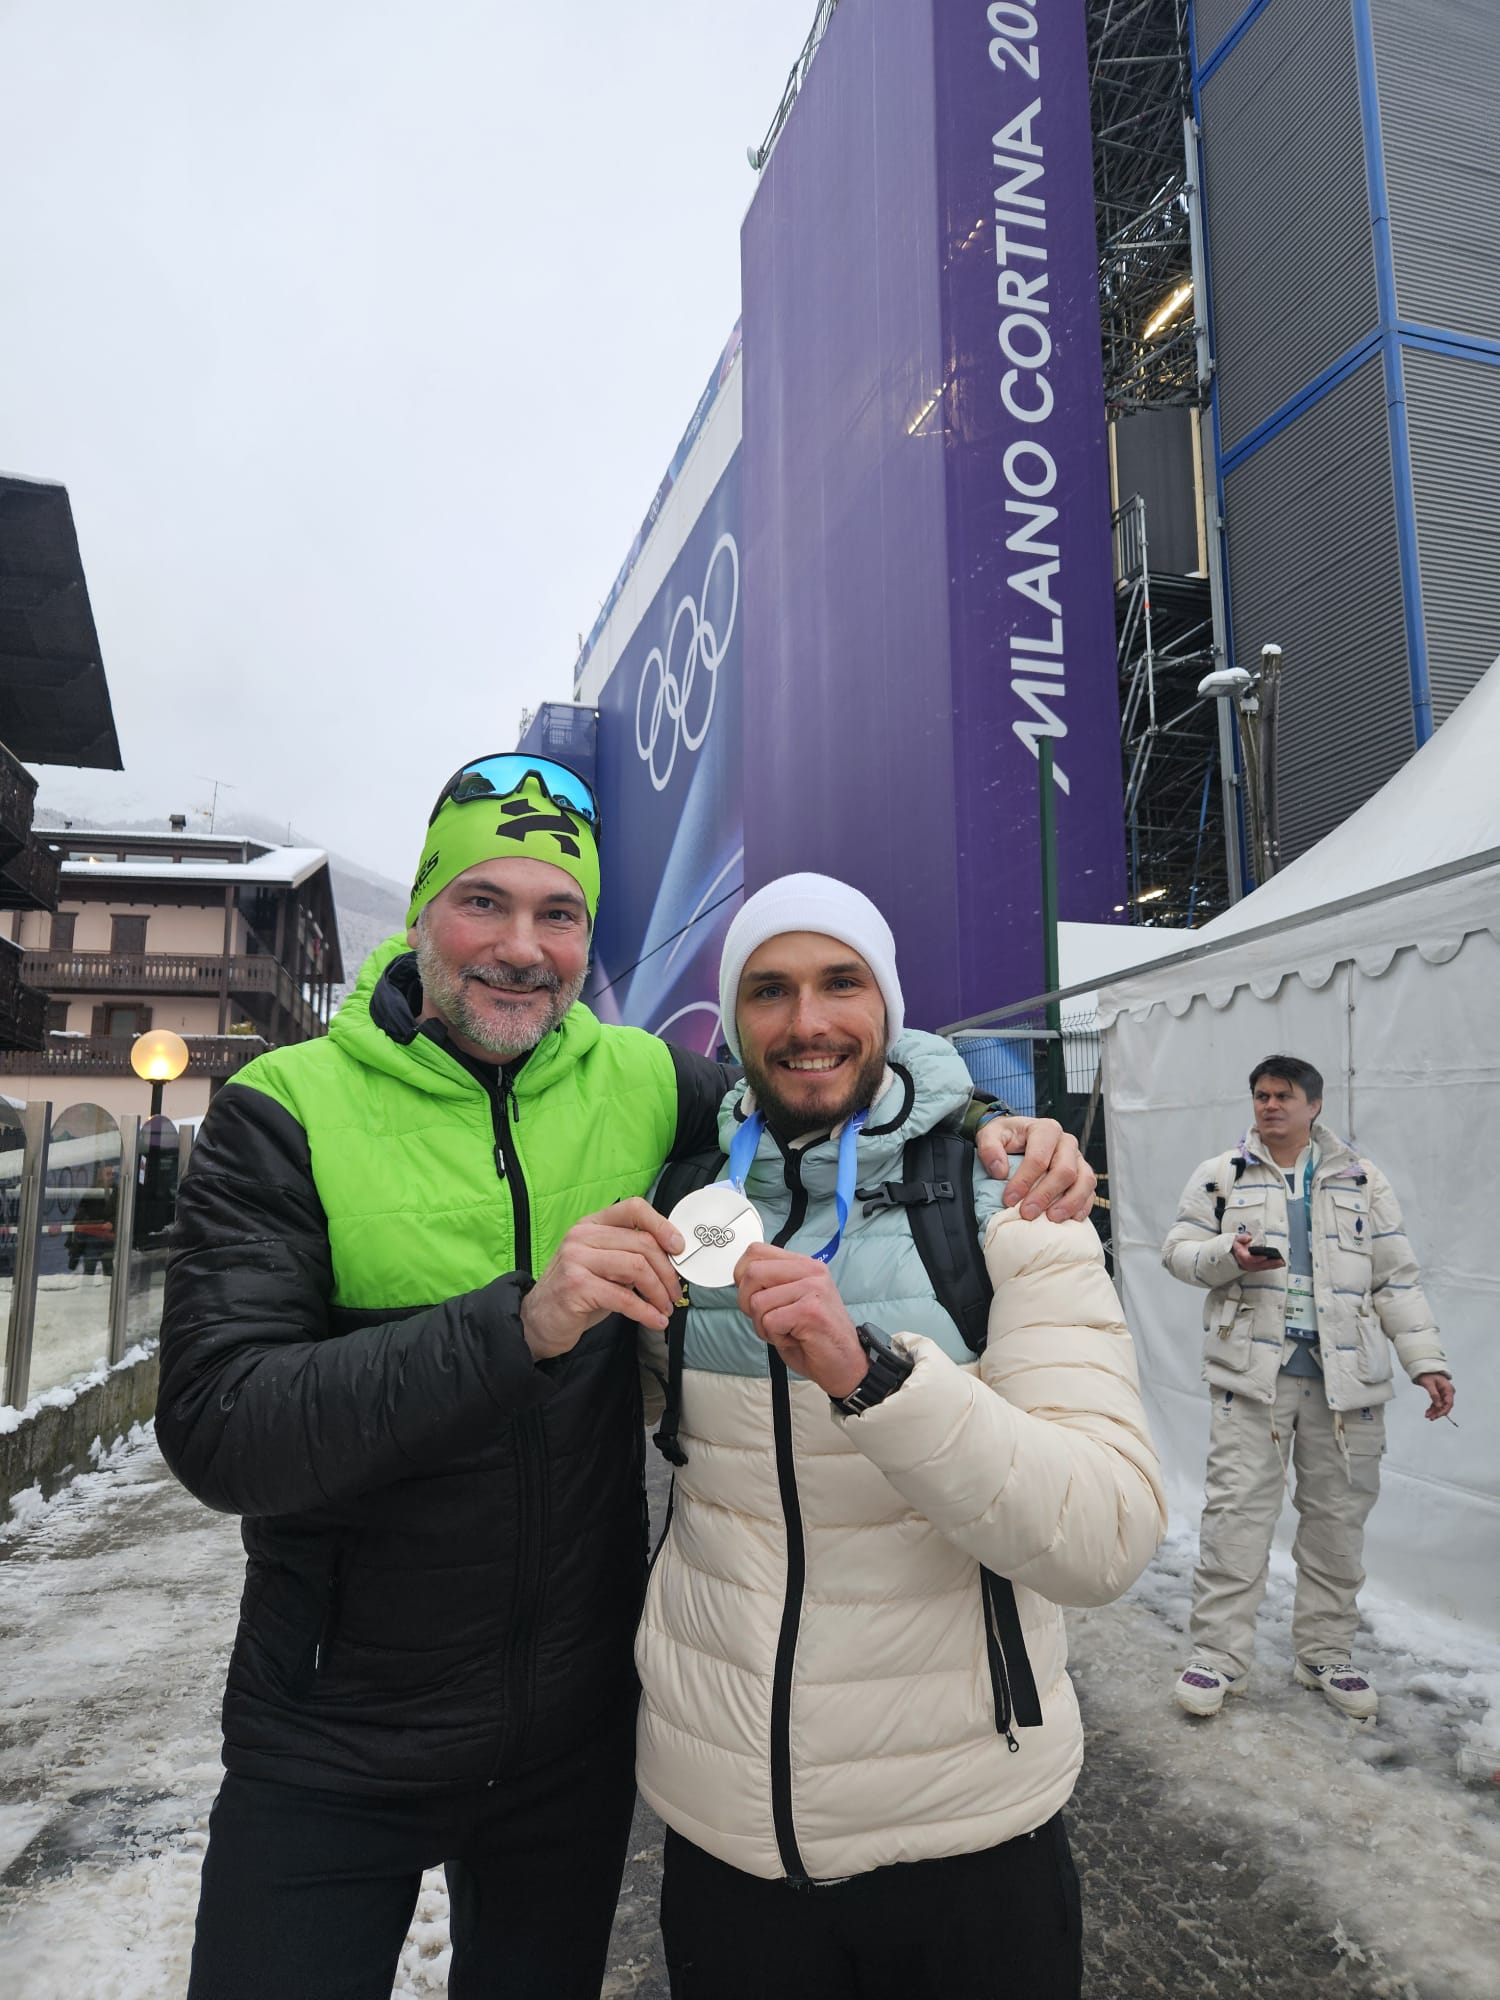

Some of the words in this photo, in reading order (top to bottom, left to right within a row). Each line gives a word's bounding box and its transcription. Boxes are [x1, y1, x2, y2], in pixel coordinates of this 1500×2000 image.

[986, 0, 1040, 80] 20
[991, 97, 1054, 423] CORTINA
[1002, 440, 1070, 796] MILANO
